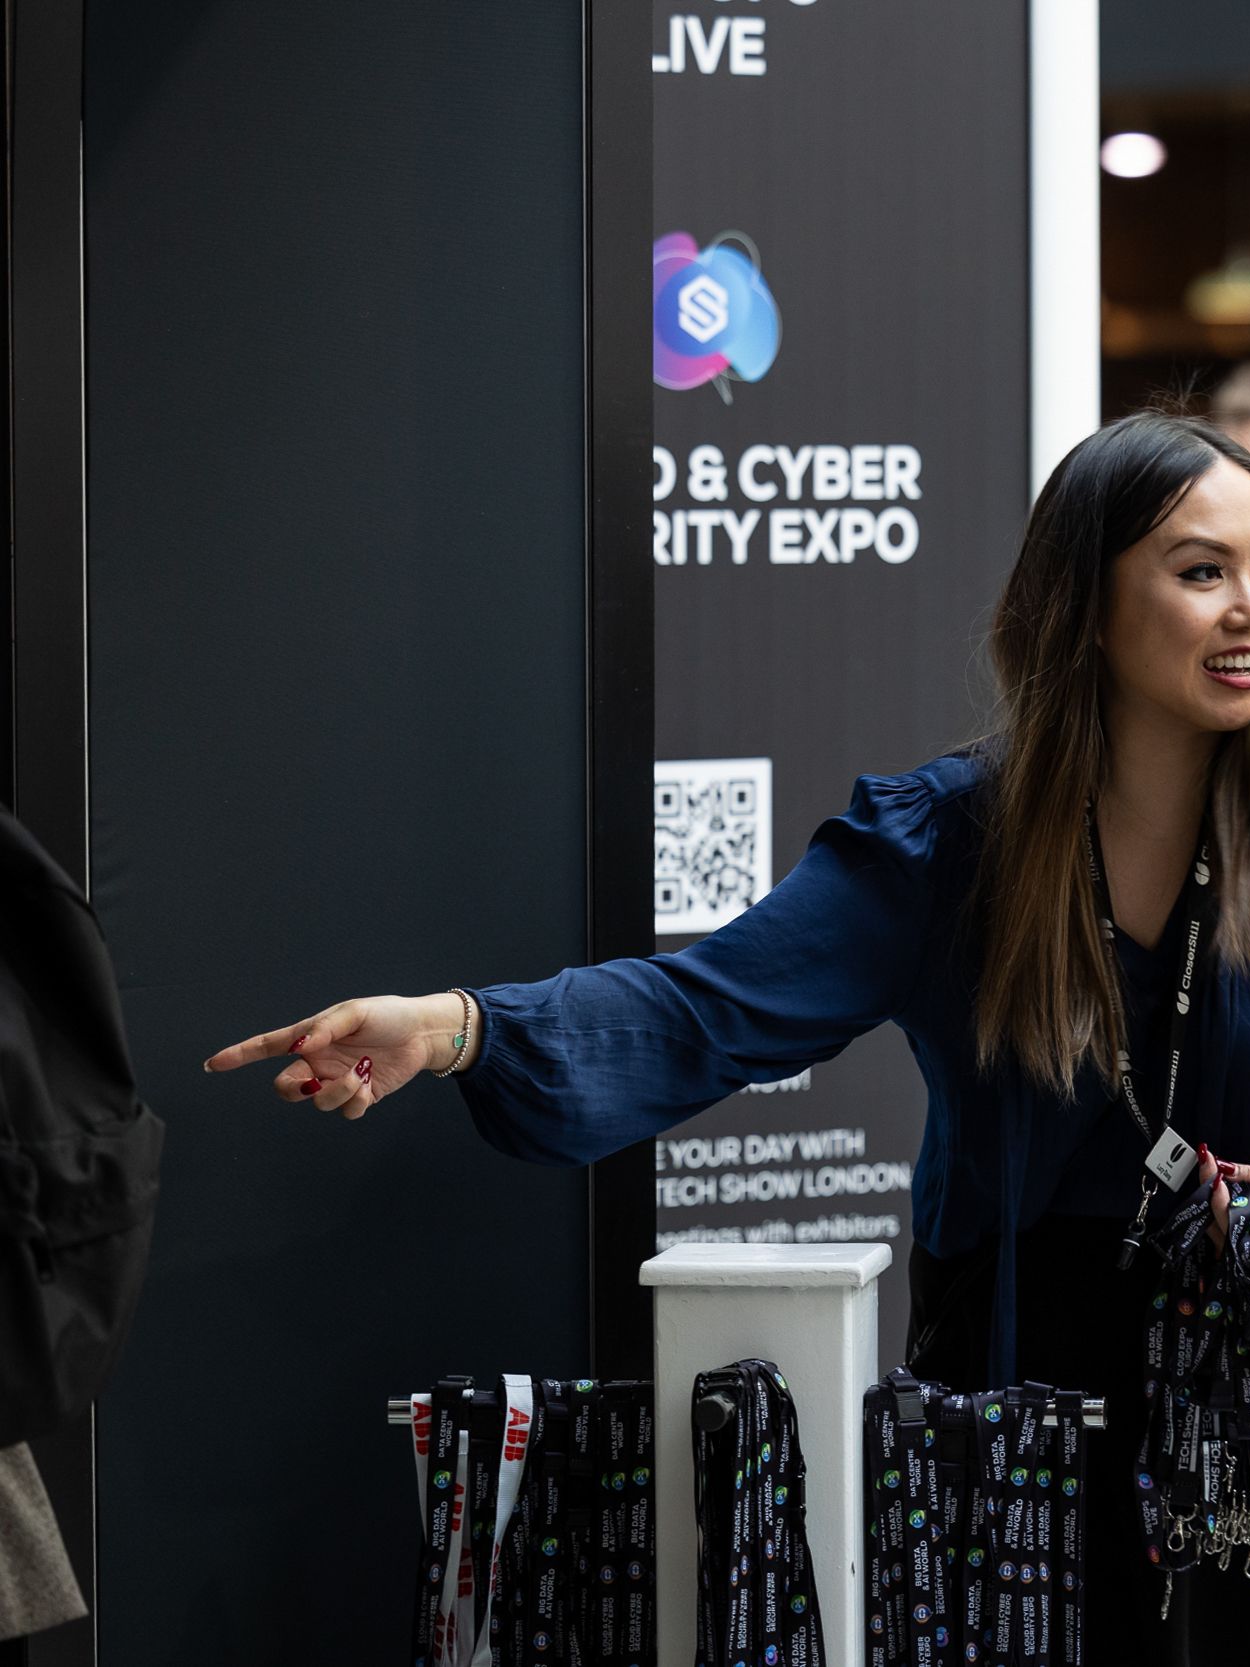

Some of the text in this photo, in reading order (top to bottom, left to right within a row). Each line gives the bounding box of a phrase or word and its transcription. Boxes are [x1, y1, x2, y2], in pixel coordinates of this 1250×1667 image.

[687, 444, 729, 501] &
[737, 444, 922, 501] CYBER
[768, 506, 920, 564] EXPO
[667, 1136, 742, 1170] YOUR
[743, 1133, 797, 1165] DAY
[797, 1127, 866, 1161] WITH
[719, 1168, 801, 1204] SHOW
[802, 1162, 912, 1199] LONDON
[795, 1213, 901, 1242] exhibitors
[1177, 1349, 1185, 1377] CLOUD
[438, 1409, 448, 1459] DATA CENTRE
[504, 1407, 530, 1461] ABB
[580, 1424, 588, 1454] CENTRE
[882, 1410, 891, 1458] DATA CENTRE
[1017, 1406, 1032, 1455] DATA CENTRE
[1025, 1418, 1036, 1445] WORLD
[1179, 1402, 1196, 1471] TECH SHOW
[611, 1441, 619, 1460] DATA
[991, 1441, 1002, 1481] BIG DATA
[998, 1434, 1006, 1465] WORLD
[908, 1449, 917, 1497] DATA CENTRE
[928, 1459, 937, 1493] WORLD
[1210, 1465, 1221, 1504] SHOW
[439, 1500, 448, 1534] WORLD
[639, 1497, 647, 1531] WORLD
[895, 1500, 903, 1532] WORLD
[972, 1487, 980, 1516] CENTRE
[1013, 1498, 1023, 1532] WORLD
[1141, 1500, 1154, 1535] DEVOPS
[1149, 1507, 1158, 1526] LIVE
[431, 1506, 441, 1547] BIG DATA
[775, 1517, 784, 1548] WORLD
[888, 1505, 898, 1546] BIG DATA
[1004, 1503, 1015, 1544] BIG DATA
[921, 1540, 929, 1573] WORLD
[935, 1555, 943, 1577] EXPO
[538, 1573, 548, 1614] BIG DATA
[546, 1568, 555, 1601] WORLD
[974, 1580, 982, 1613] WORLD
[996, 1593, 1006, 1652] CLOUD CYBER
[1002, 1616, 1010, 1653] SECURITY
[791, 1632, 799, 1654] DATA
